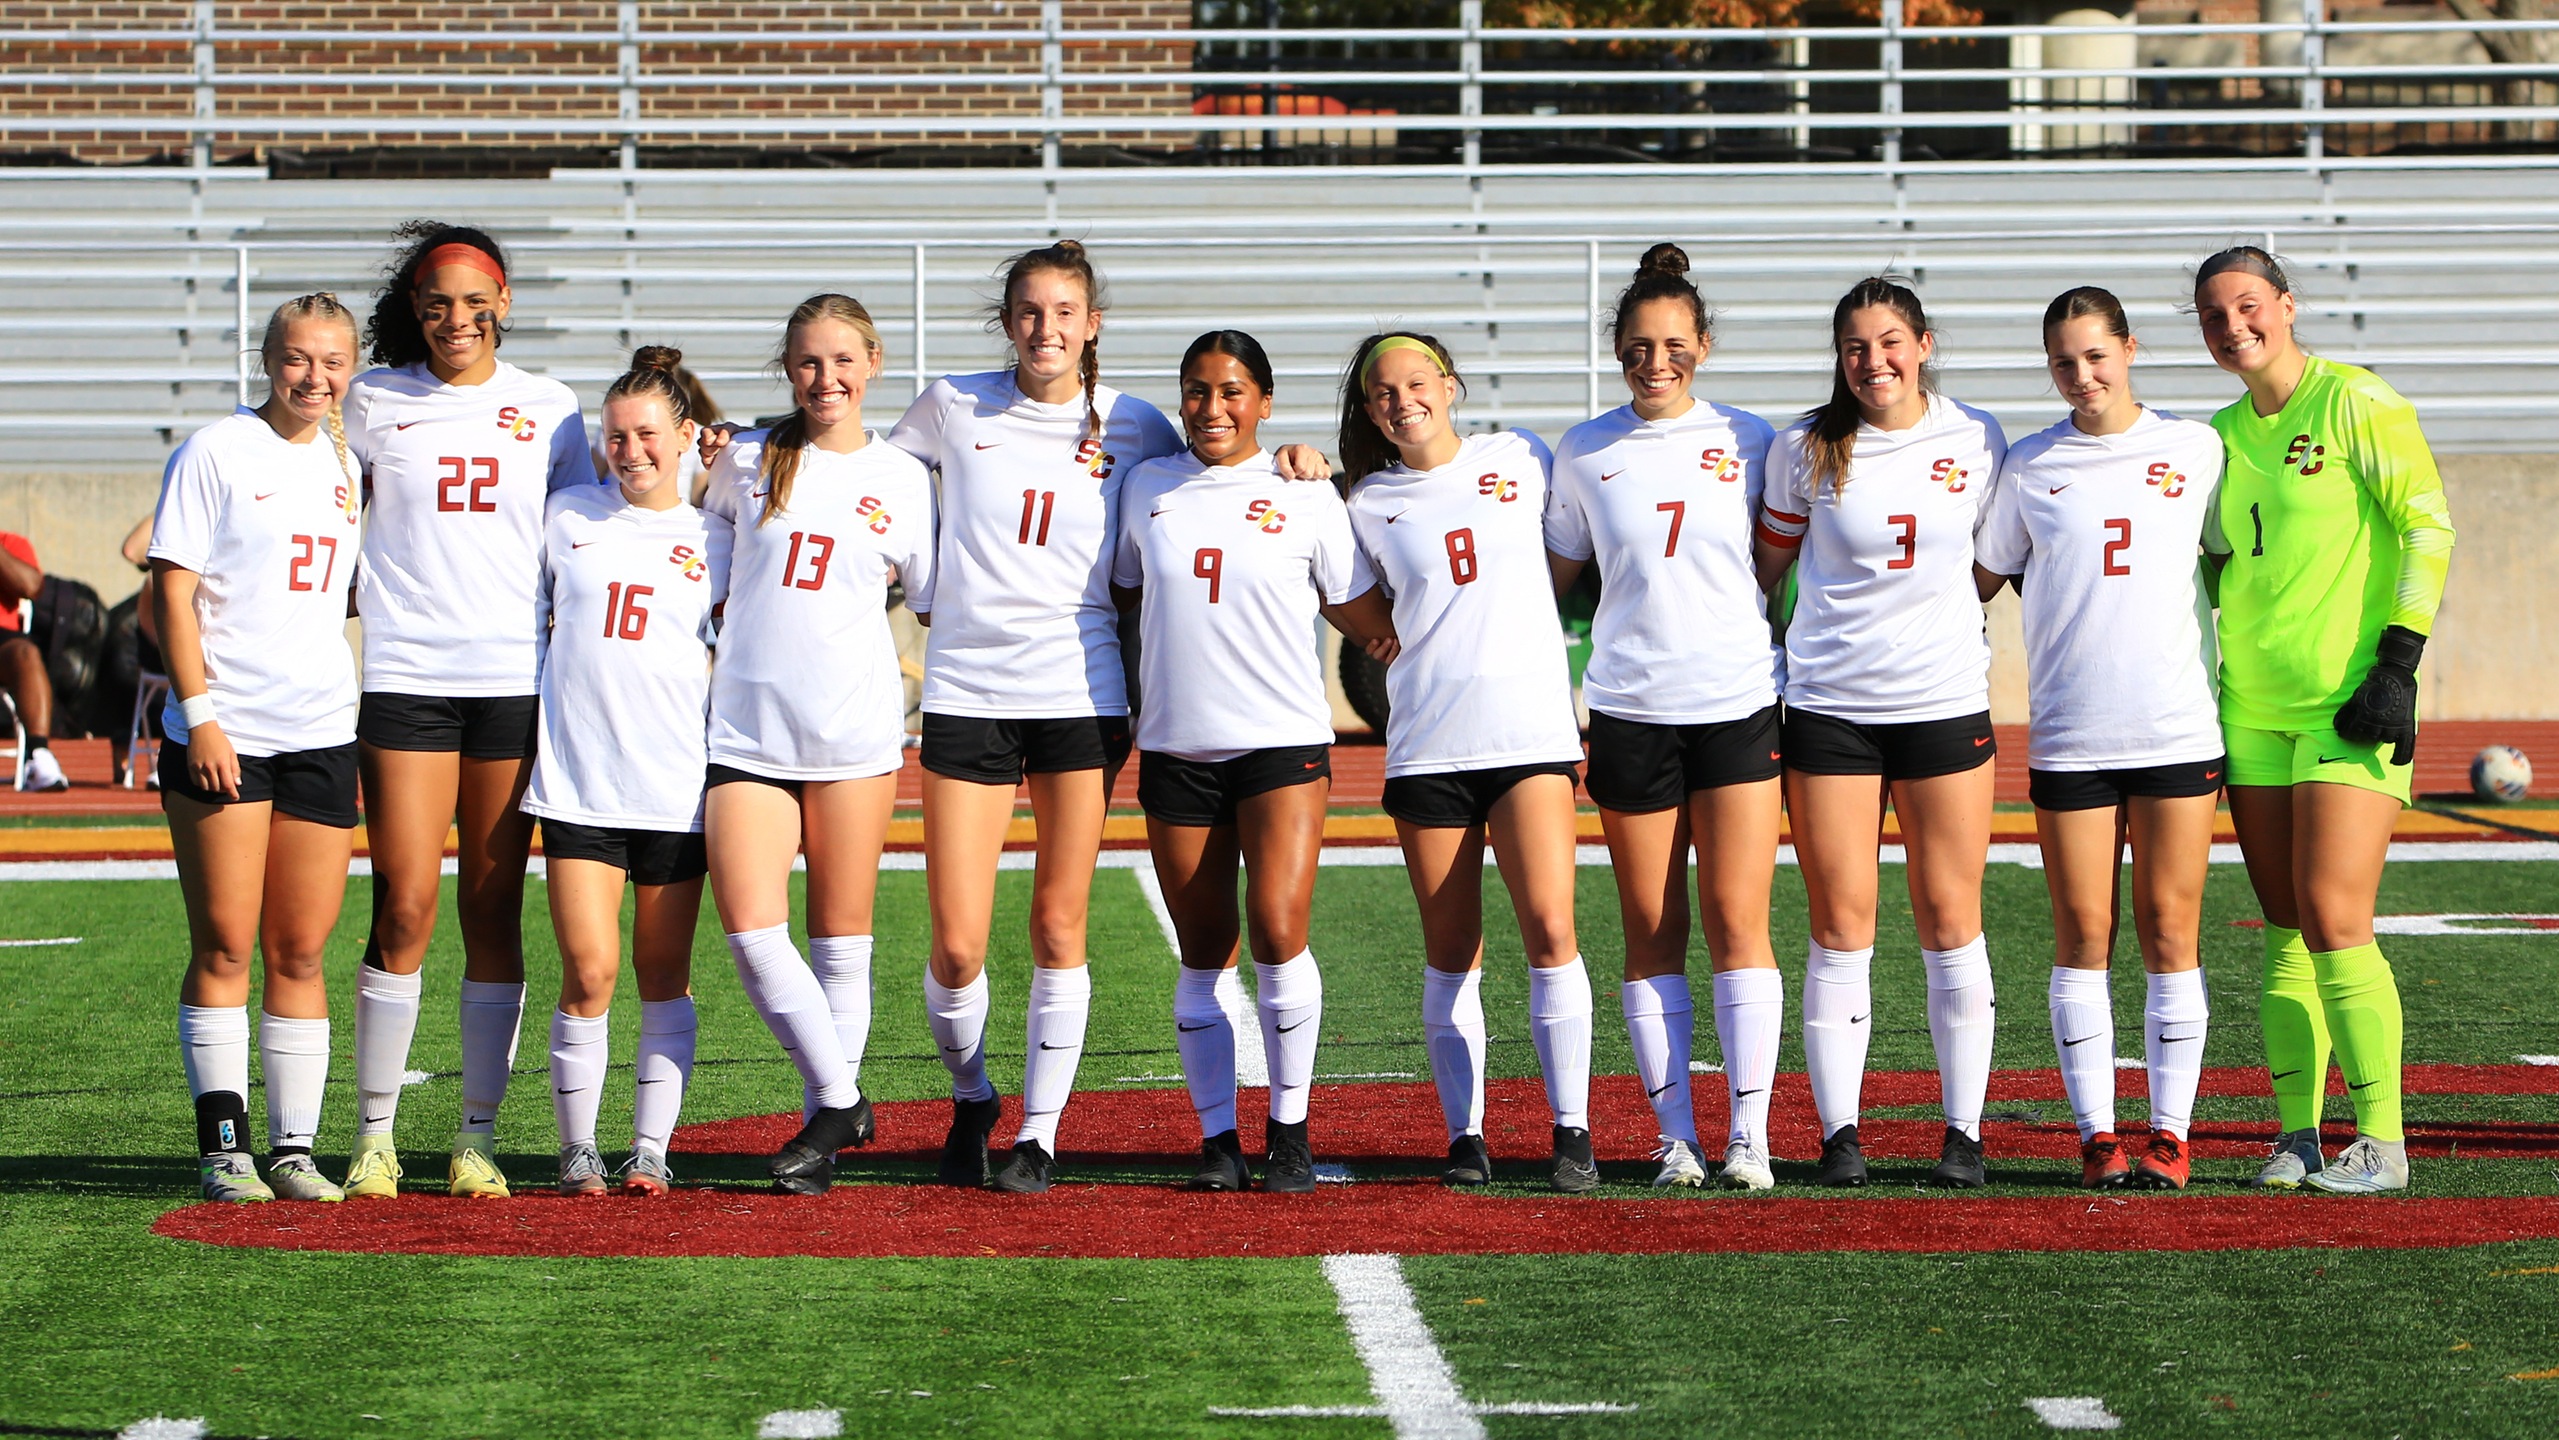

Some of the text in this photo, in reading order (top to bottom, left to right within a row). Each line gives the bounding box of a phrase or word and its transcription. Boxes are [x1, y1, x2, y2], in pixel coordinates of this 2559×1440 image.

[497, 407, 536, 441] SC
[1075, 439, 1115, 479] SC
[1700, 449, 1740, 483] SC
[1930, 458, 1968, 493] SC
[2146, 463, 2186, 498] SC
[2284, 434, 2325, 476] SC
[438, 457, 499, 513] 22
[1478, 473, 1518, 503] SC
[856, 496, 892, 535] SC
[1018, 489, 1055, 546] 11
[1246, 499, 1286, 534] SC
[1656, 501, 1685, 558] 7
[1887, 514, 1917, 570] 3
[2250, 502, 2264, 557] 1
[289, 534, 337, 593] 27
[669, 545, 706, 582] SC
[782, 531, 835, 591] 13
[1445, 527, 1478, 586] 8
[2103, 518, 2132, 577] 2
[1194, 548, 1223, 604] 9
[603, 581, 654, 641] 16
